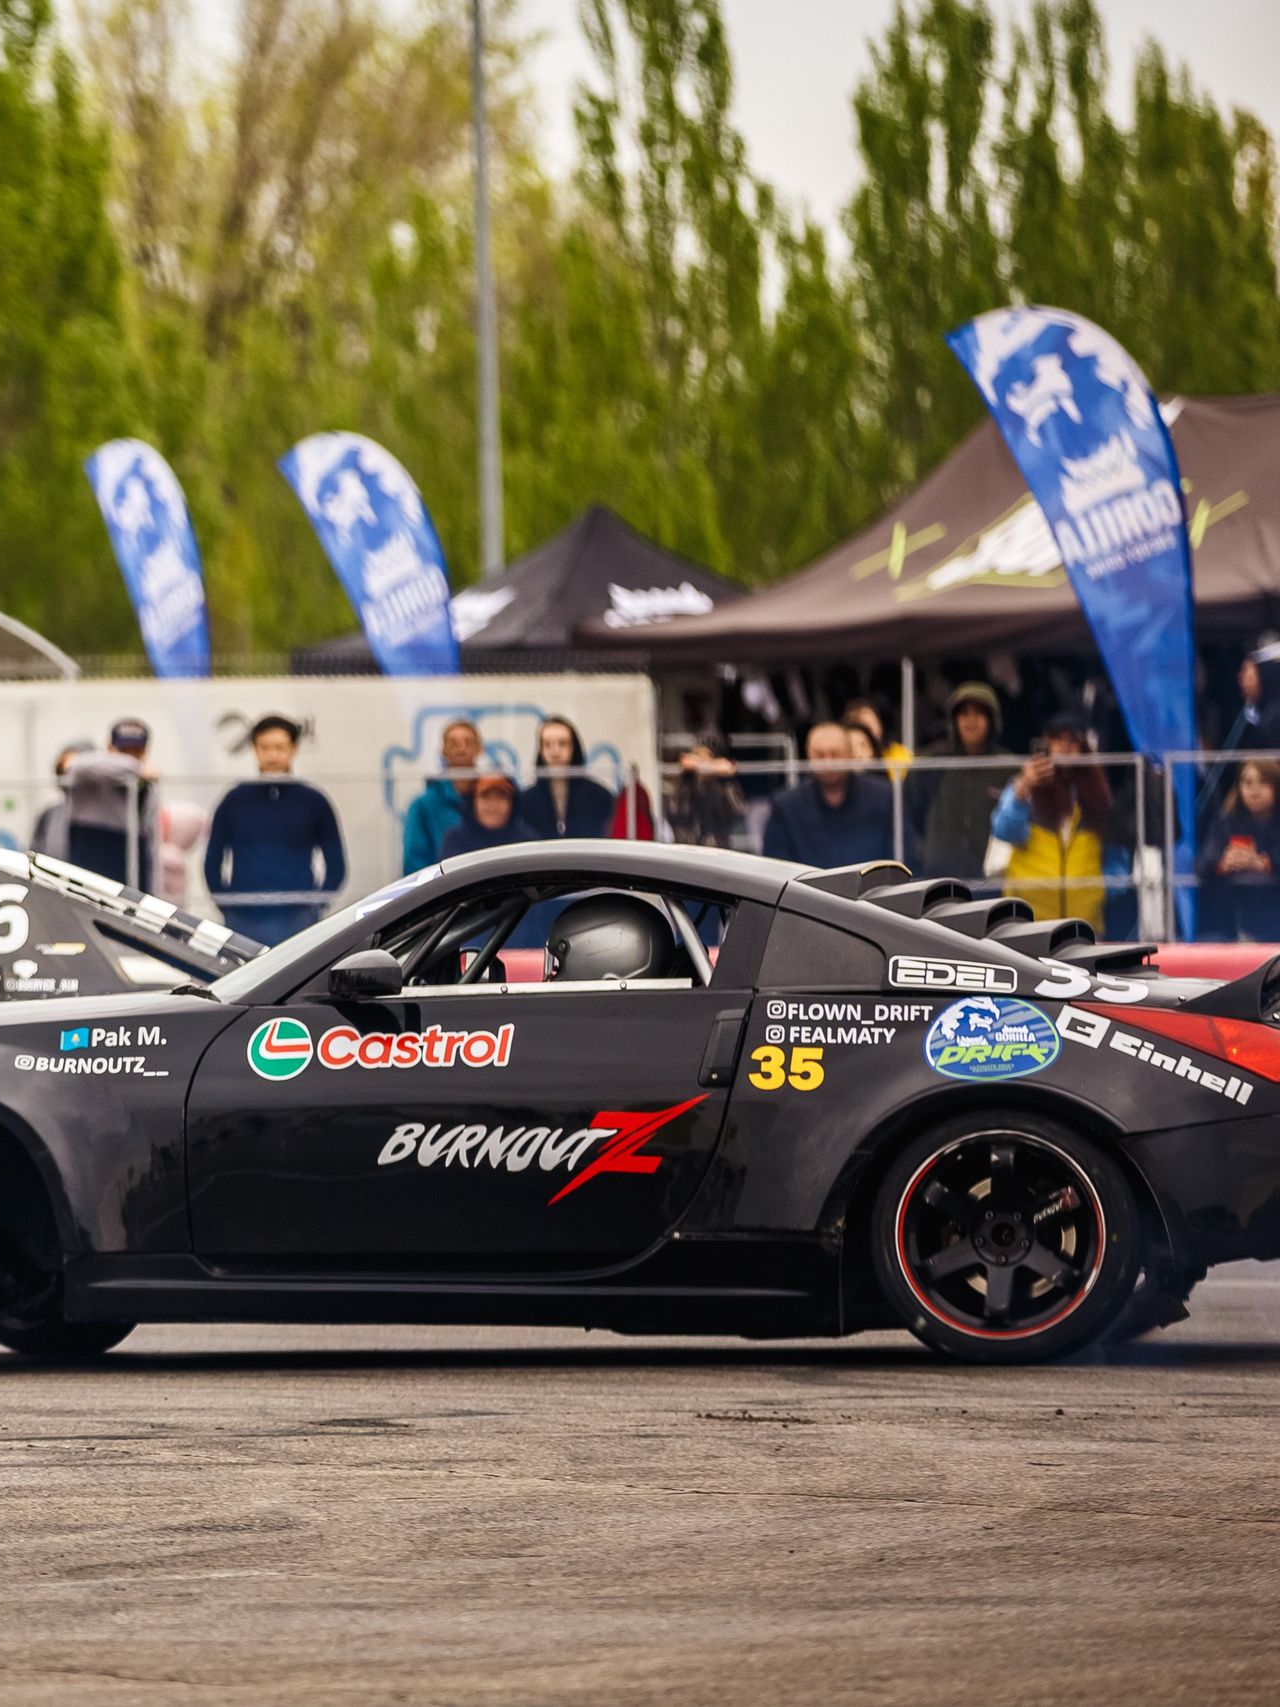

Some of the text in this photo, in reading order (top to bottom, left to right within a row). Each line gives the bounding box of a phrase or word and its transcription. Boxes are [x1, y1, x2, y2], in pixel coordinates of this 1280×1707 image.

[897, 959, 1012, 989] EDEL
[1034, 957, 1149, 1003] 35
[788, 1003, 933, 1024] FLOWN_DRIFT
[91, 1026, 167, 1047] Pak M.
[318, 1024, 514, 1069] Castrol
[789, 1026, 896, 1044] FEALMATY
[995, 1032, 1036, 1042] GORILLA
[748, 1045, 825, 1091] 35
